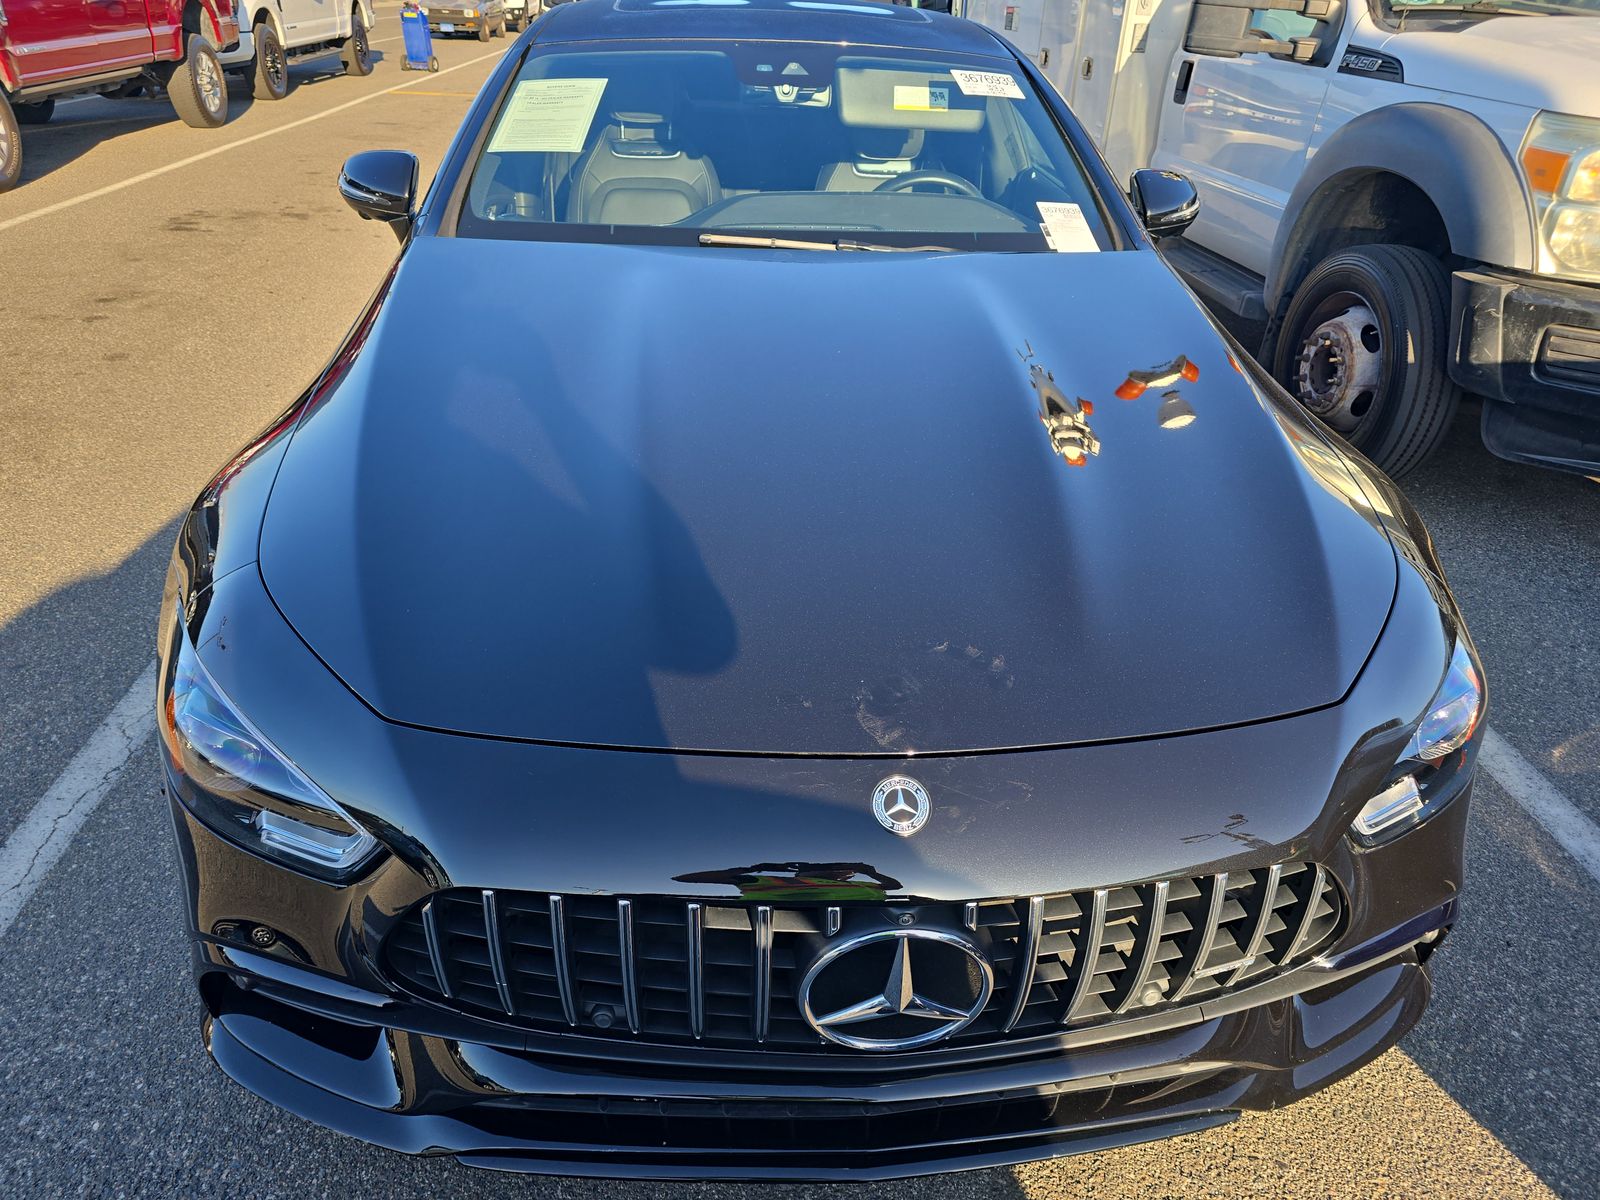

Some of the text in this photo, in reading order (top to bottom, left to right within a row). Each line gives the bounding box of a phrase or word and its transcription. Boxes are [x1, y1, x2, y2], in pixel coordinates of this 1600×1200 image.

[1342, 55, 1382, 71] F-450
[960, 73, 1016, 87] 3676939
[893, 823, 914, 831] BENZ
